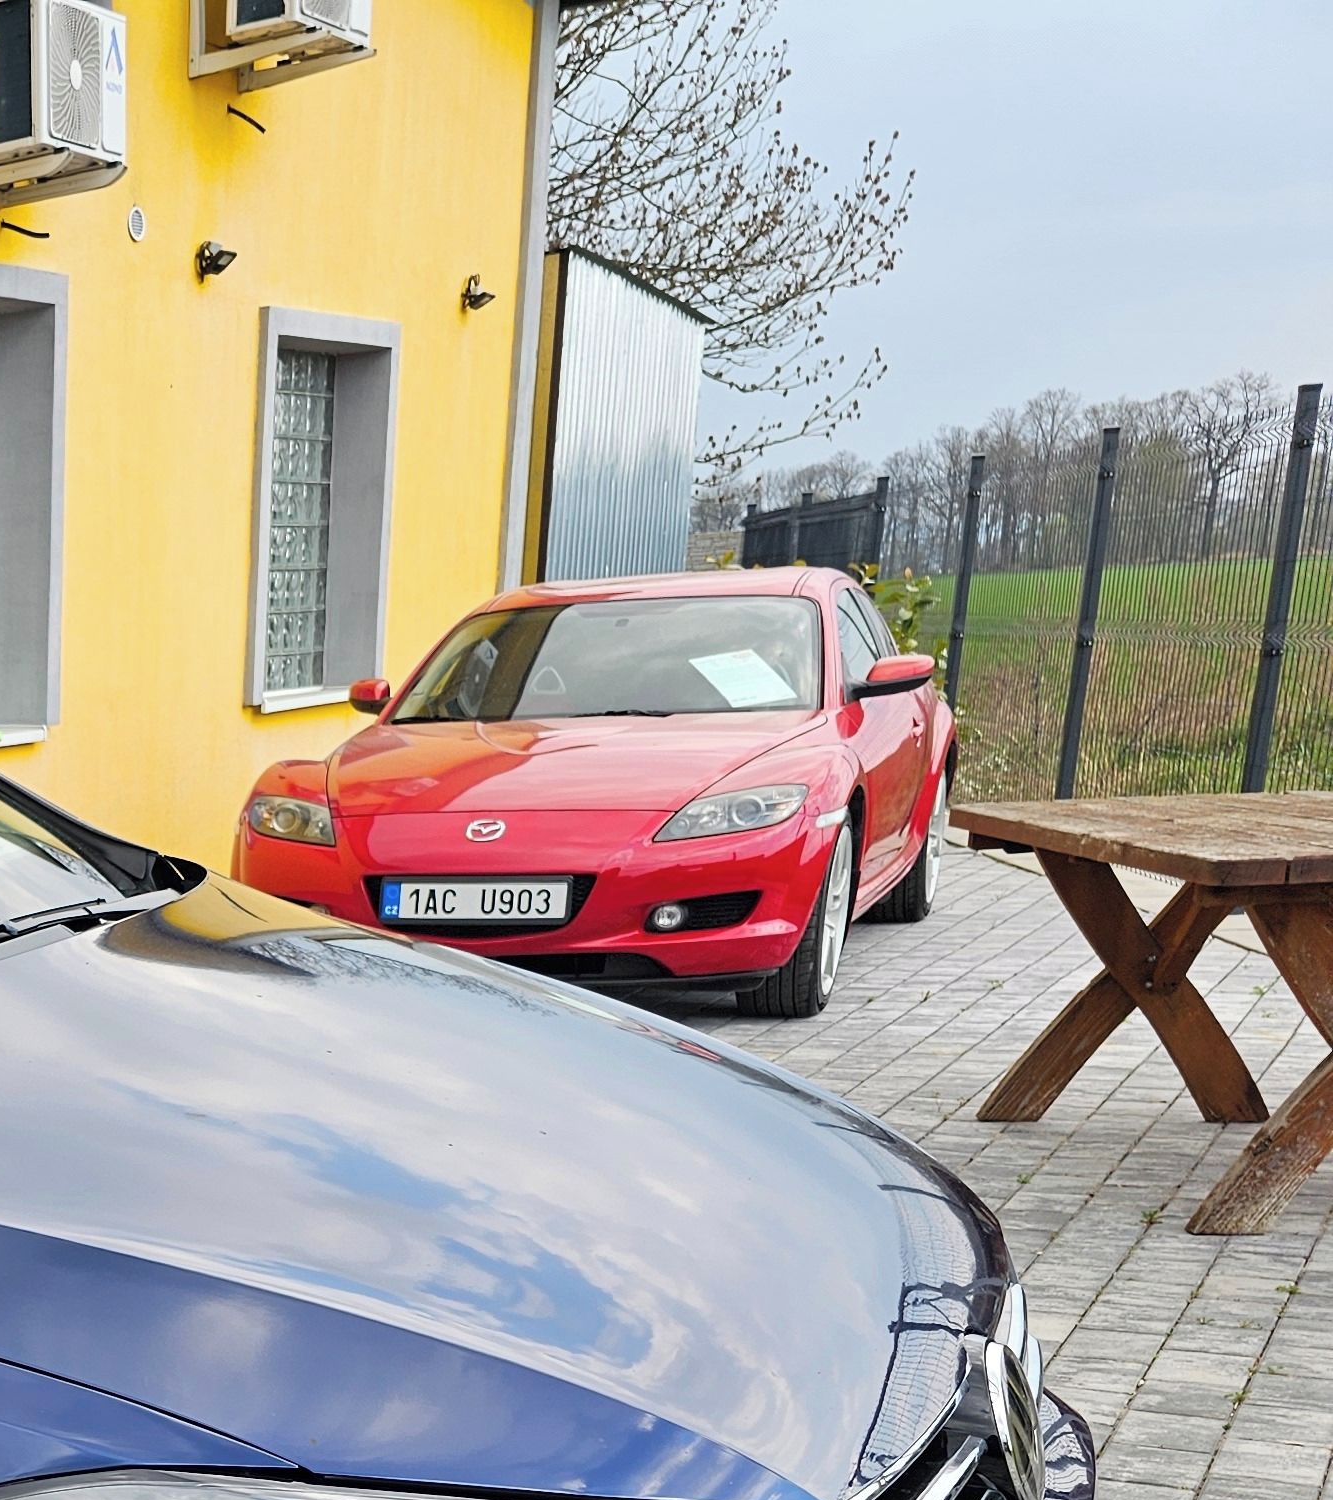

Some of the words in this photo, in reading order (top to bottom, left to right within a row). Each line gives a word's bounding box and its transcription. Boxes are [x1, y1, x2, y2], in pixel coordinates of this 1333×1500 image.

[385, 905, 398, 915] CZ
[409, 888, 457, 915] 1AC
[480, 888, 552, 915] U903
